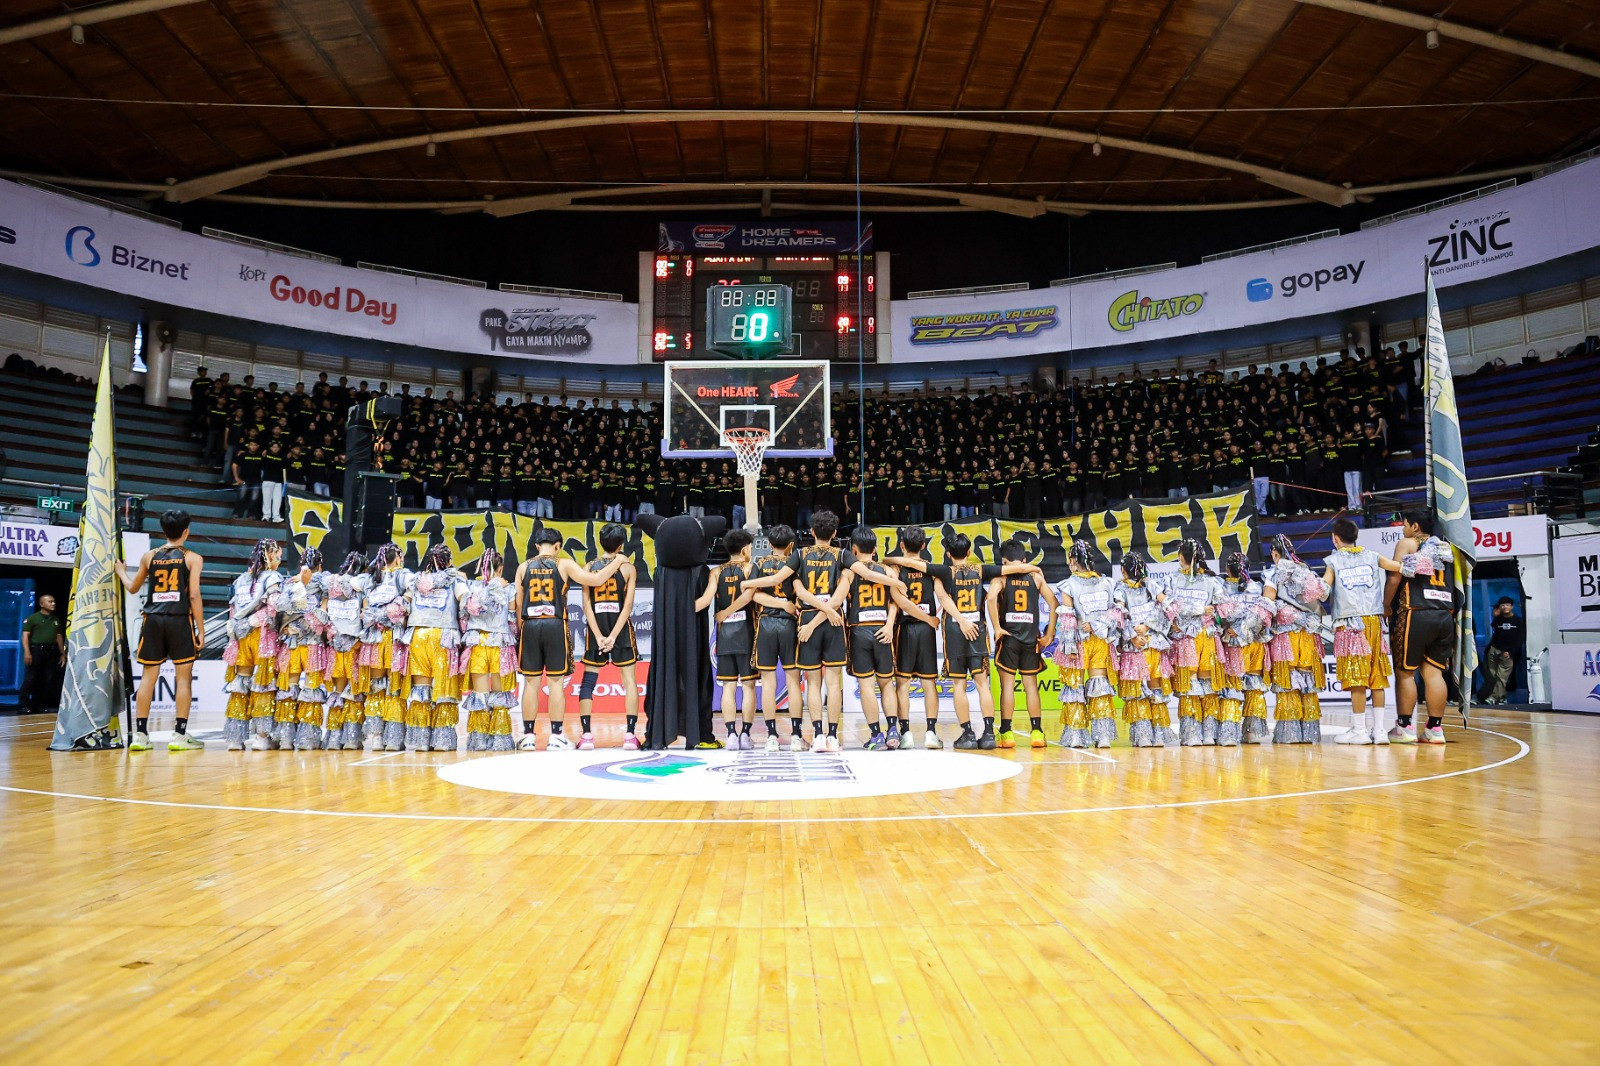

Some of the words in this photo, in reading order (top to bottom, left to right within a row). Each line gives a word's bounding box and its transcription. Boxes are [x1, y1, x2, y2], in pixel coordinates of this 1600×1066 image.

[742, 228, 791, 236] HOME
[742, 237, 837, 246] DREAMERS
[112, 245, 189, 280] Biznet
[1446, 260, 1480, 273] DANDRUFF
[1482, 250, 1514, 264] SHAMPOO
[1280, 260, 1366, 298] gopay
[270, 275, 340, 310] Good
[346, 288, 397, 324] Day
[485, 318, 502, 327] PAKE
[504, 314, 597, 333] STREET
[912, 316, 944, 326] YANG
[945, 314, 987, 325] WORTH
[1006, 310, 1020, 319] YA
[1022, 307, 1056, 317] CUMA
[506, 336, 524, 346] GAYA
[527, 336, 552, 346] MAKIN
[697, 386, 719, 397] One
[721, 386, 759, 397] HEART.
[41, 499, 70, 510] EXIT
[0, 542, 44, 557] MILK
[155, 568, 178, 592] 34
[529, 578, 554, 602] 23
[594, 578, 618, 602] 22
[808, 570, 830, 594] 14
[858, 584, 885, 607] 20
[910, 582, 923, 605] 3
[957, 589, 977, 612] 21
[1014, 590, 1028, 612] 9
